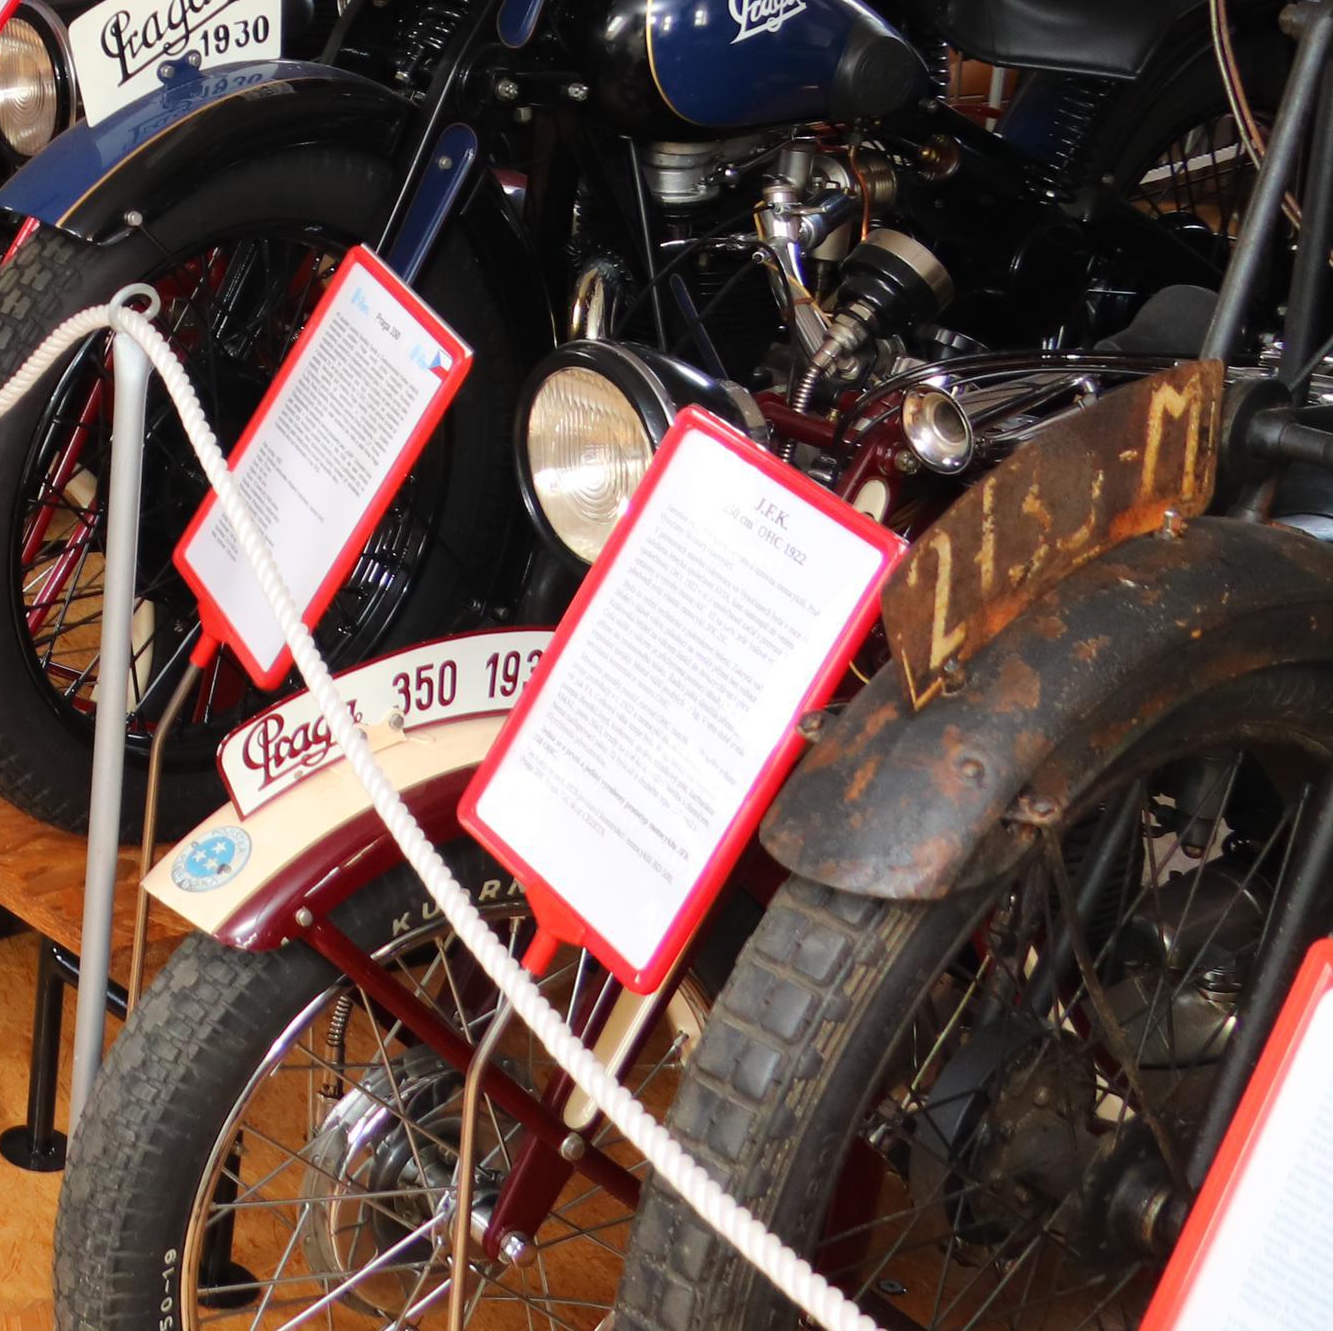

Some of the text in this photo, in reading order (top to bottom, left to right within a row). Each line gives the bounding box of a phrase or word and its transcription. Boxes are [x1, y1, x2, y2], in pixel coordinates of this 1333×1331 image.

[199, 15, 269, 57] 1930
[754, 498, 790, 530] J.F.K.
[758, 525, 807, 566] OHC 1922
[392, 660, 458, 717] 350
